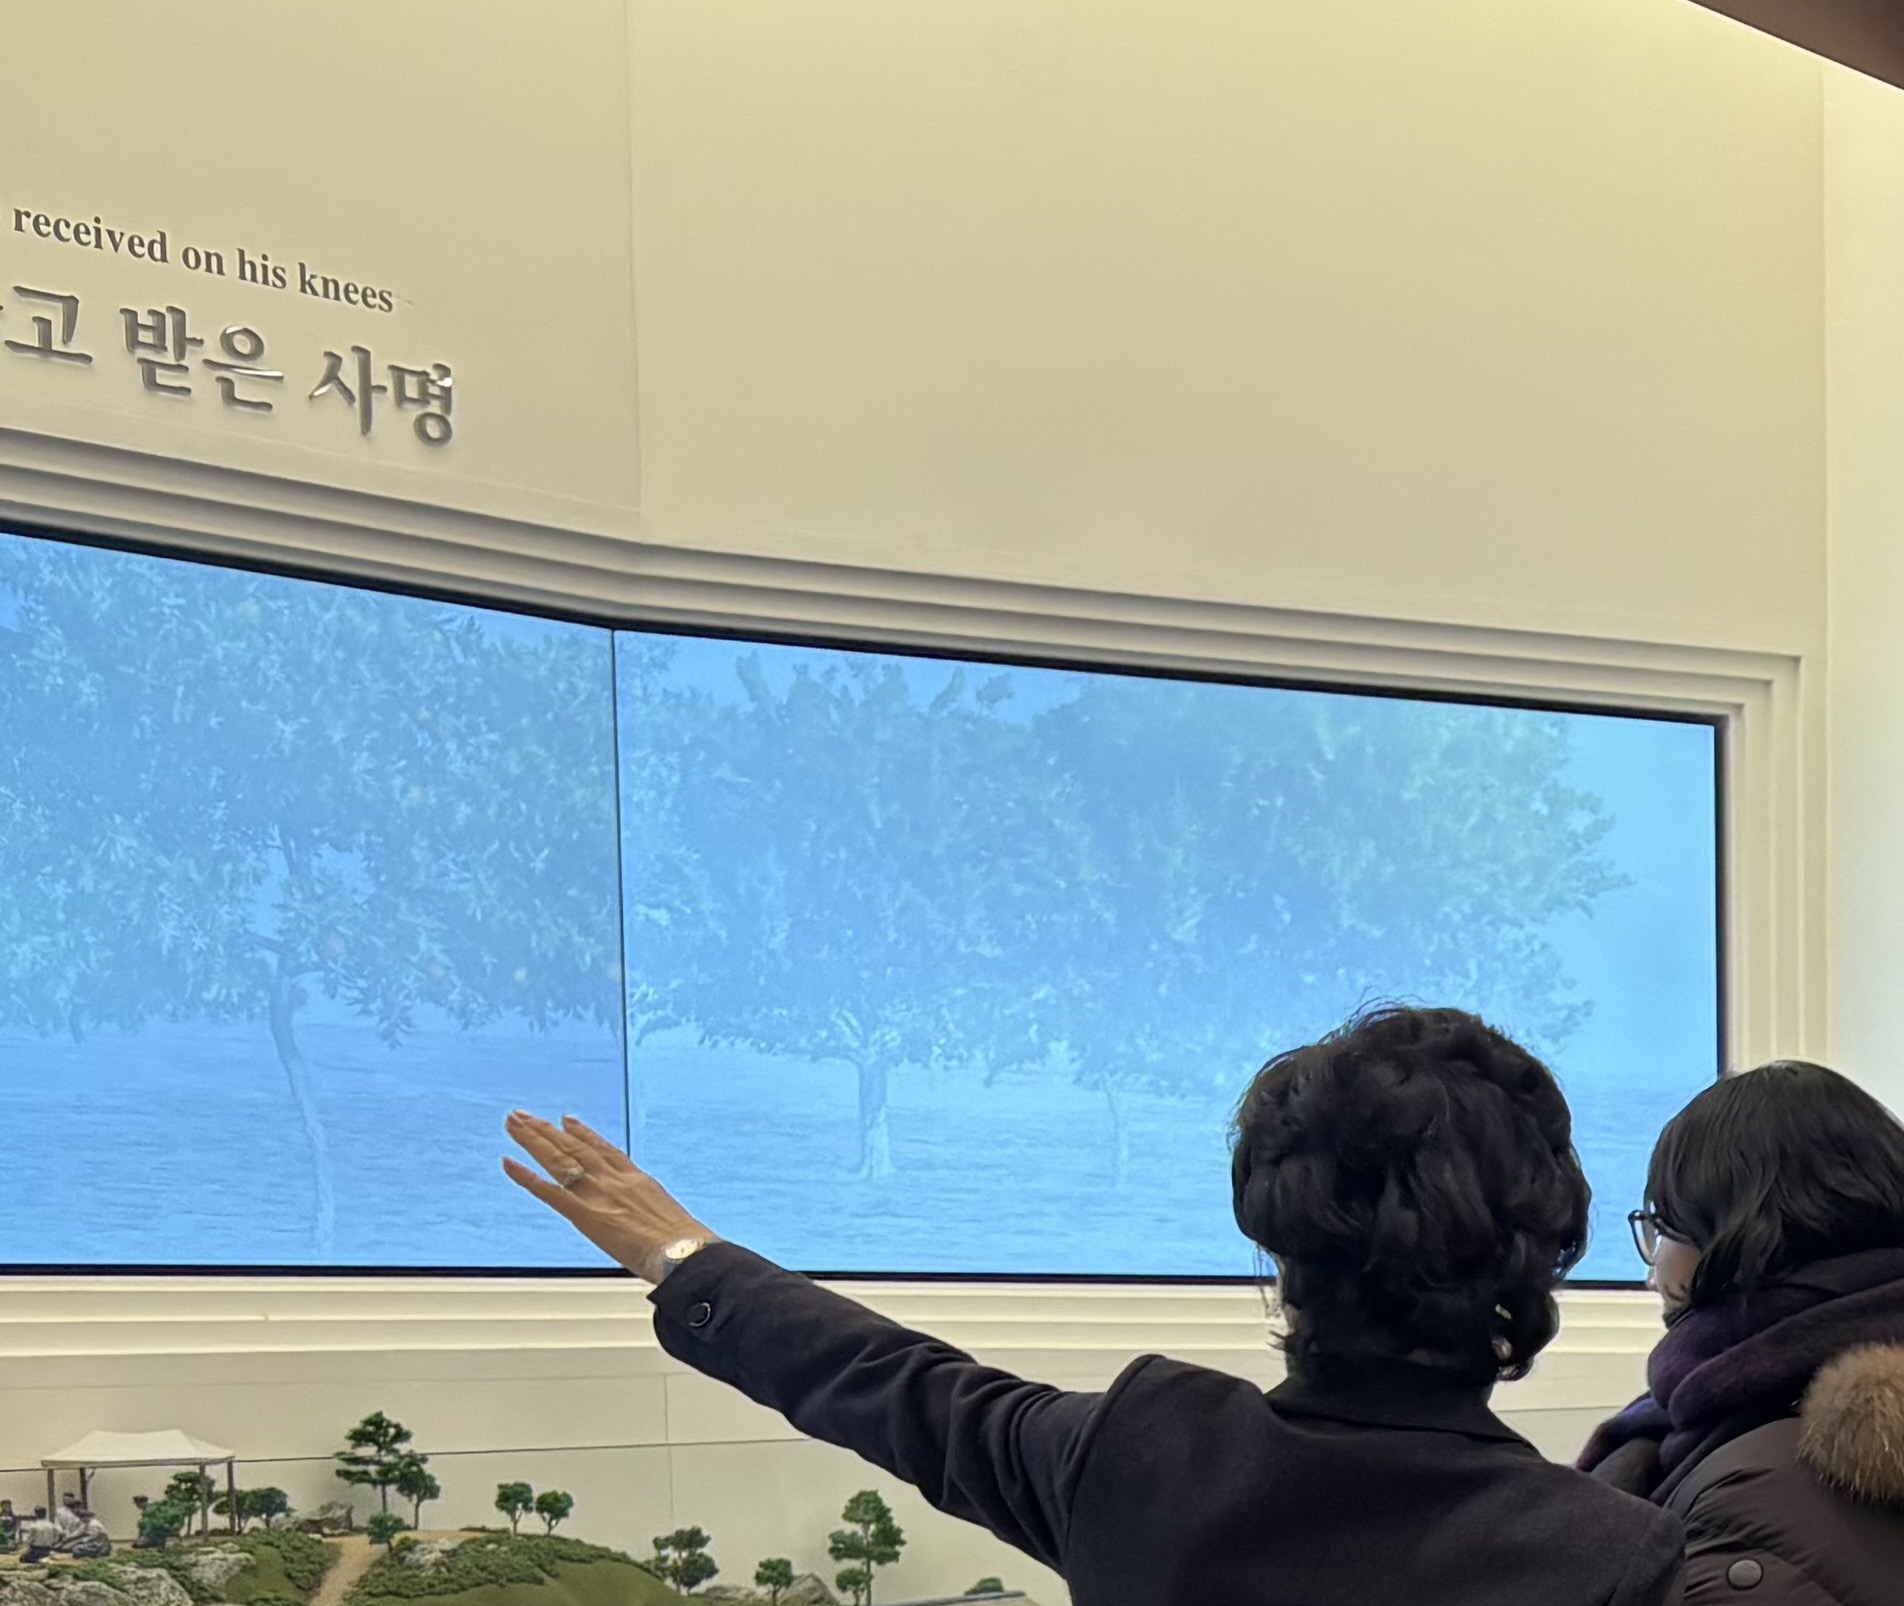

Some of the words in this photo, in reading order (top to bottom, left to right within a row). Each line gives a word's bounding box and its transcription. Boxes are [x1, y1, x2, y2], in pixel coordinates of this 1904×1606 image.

[12, 205, 169, 264] received
[181, 244, 226, 277] on
[236, 247, 288, 291] his
[298, 261, 394, 314] knees
[0, 285, 94, 364] 고
[119, 305, 285, 413] 받은
[308, 344, 455, 448] 사명
